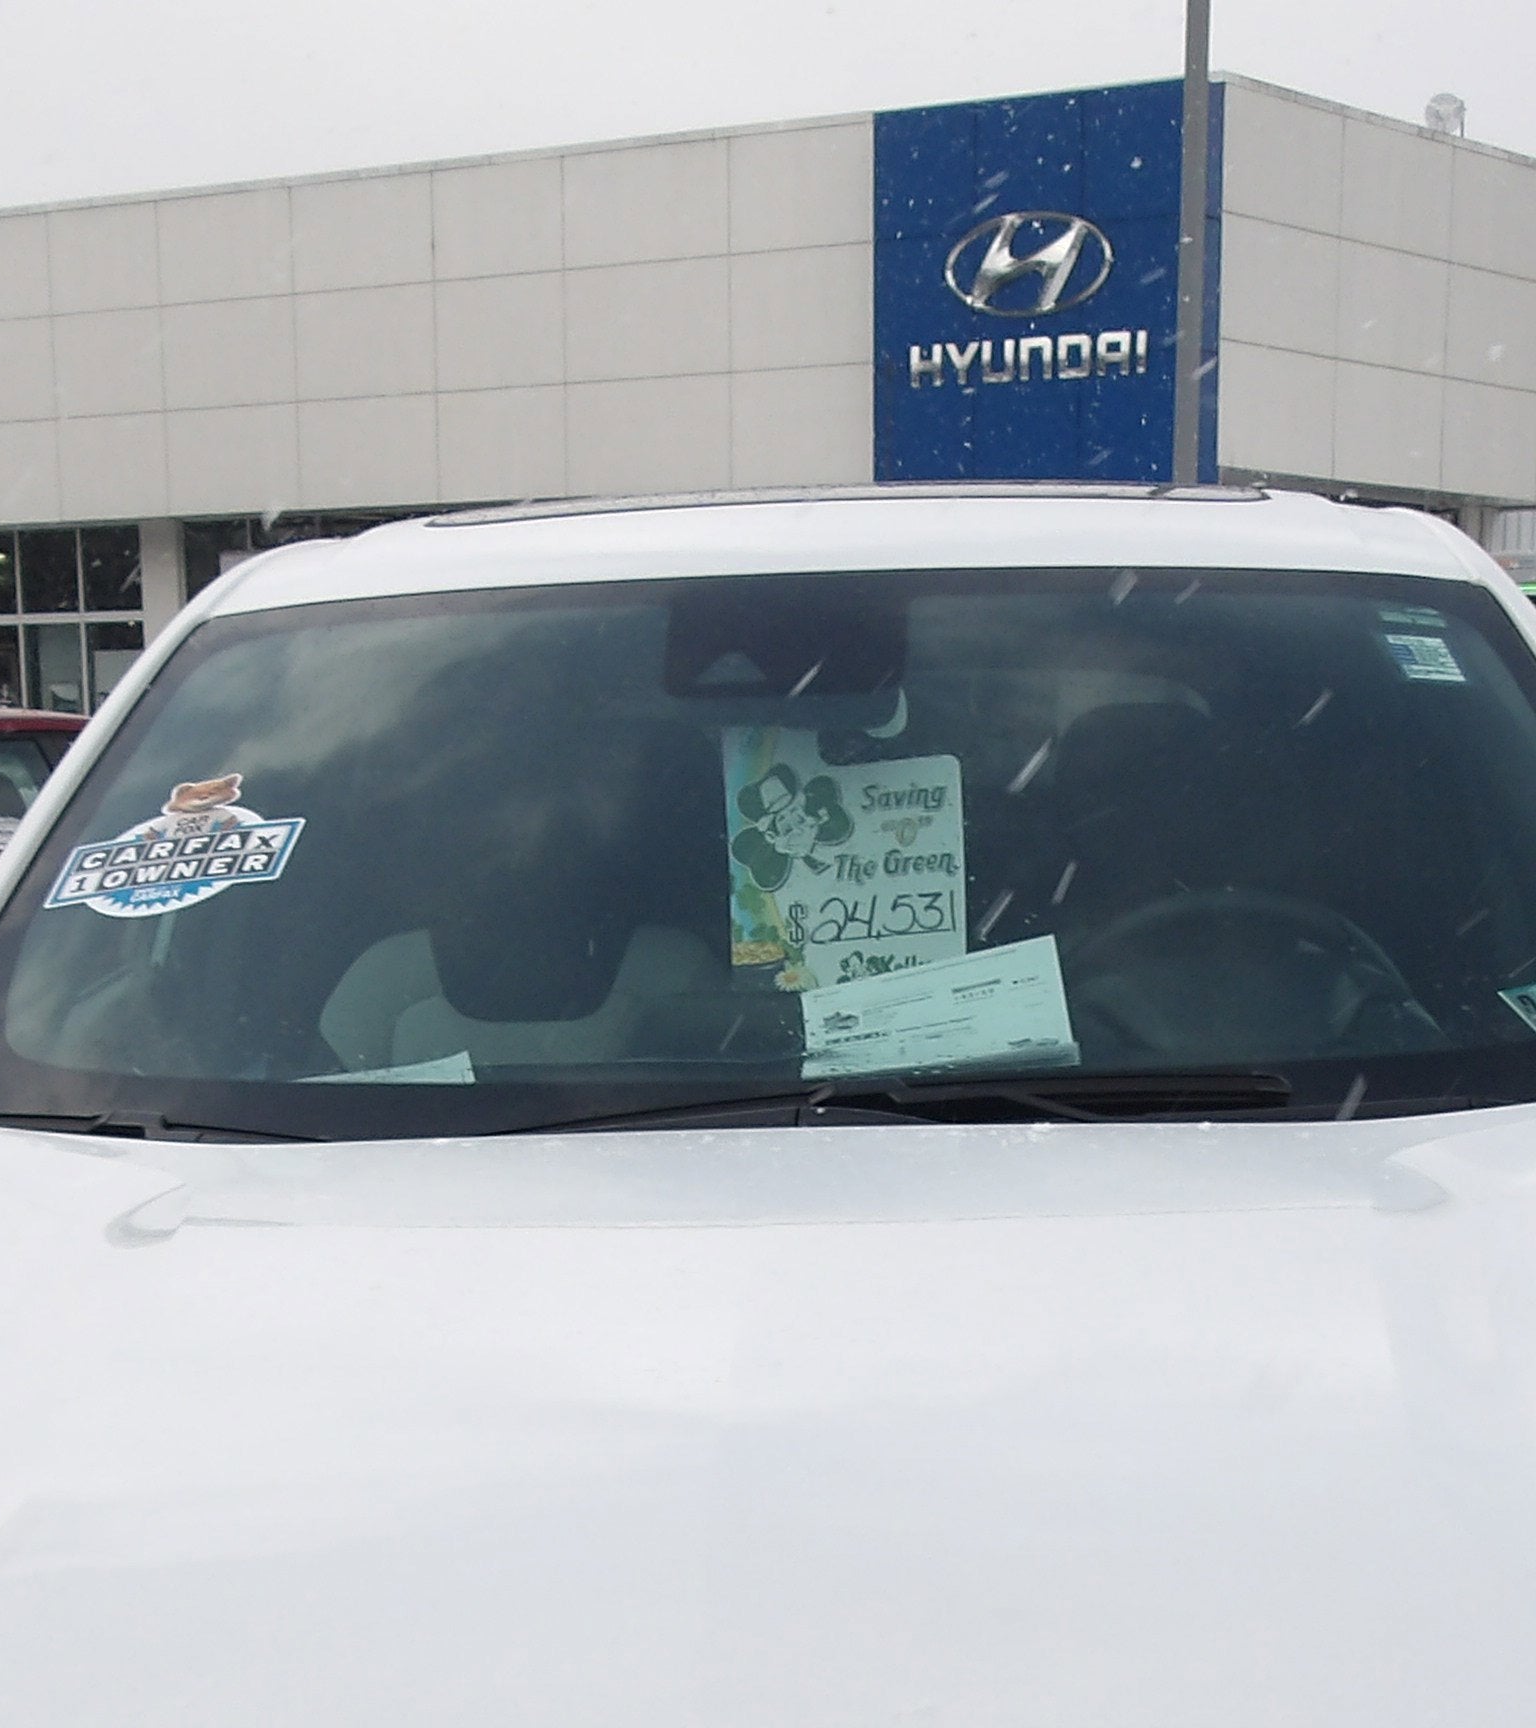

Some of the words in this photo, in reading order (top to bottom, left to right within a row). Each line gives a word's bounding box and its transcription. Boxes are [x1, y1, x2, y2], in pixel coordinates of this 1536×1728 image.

[910, 329, 1147, 389] HYUNDAI
[861, 783, 947, 812] Saving
[83, 834, 278, 869] CARFAX
[834, 852, 878, 885] The
[70, 876, 91, 893] 1
[101, 853, 270, 890] OWNER
